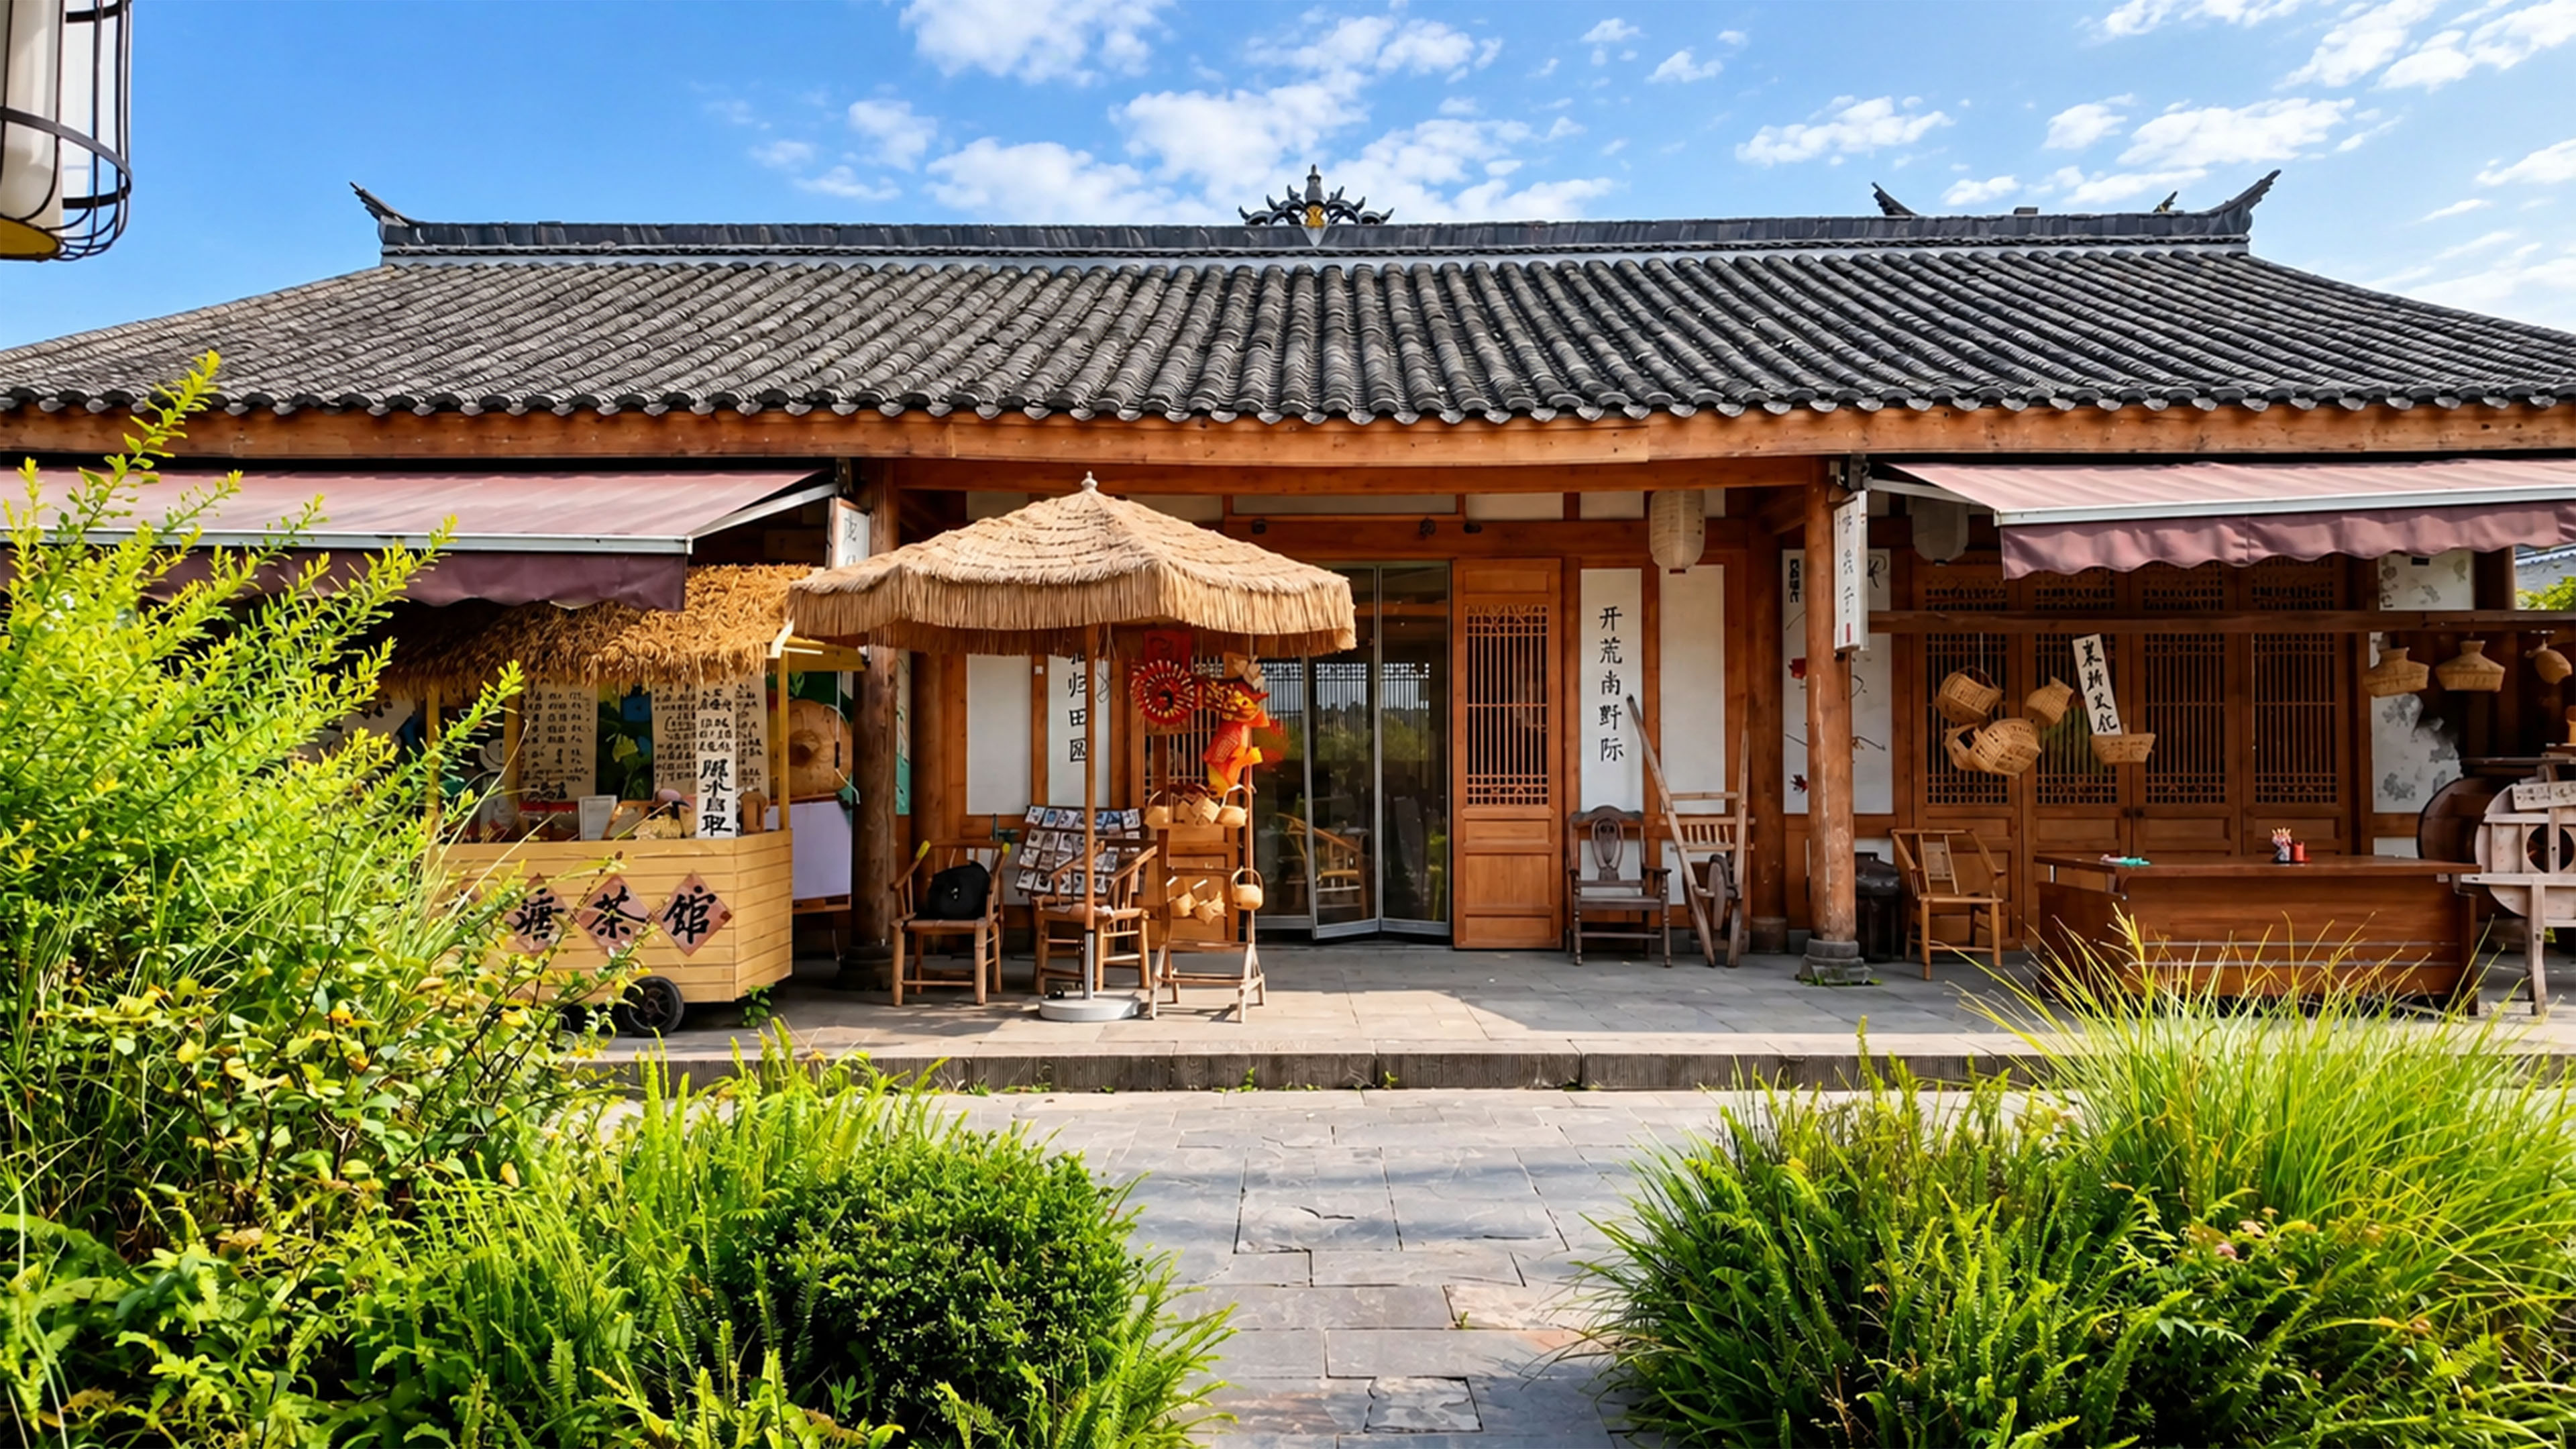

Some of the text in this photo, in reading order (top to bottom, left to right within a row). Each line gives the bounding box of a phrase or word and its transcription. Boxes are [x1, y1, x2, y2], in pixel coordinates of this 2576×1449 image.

[1599, 606, 1624, 762] 开荒南野际
